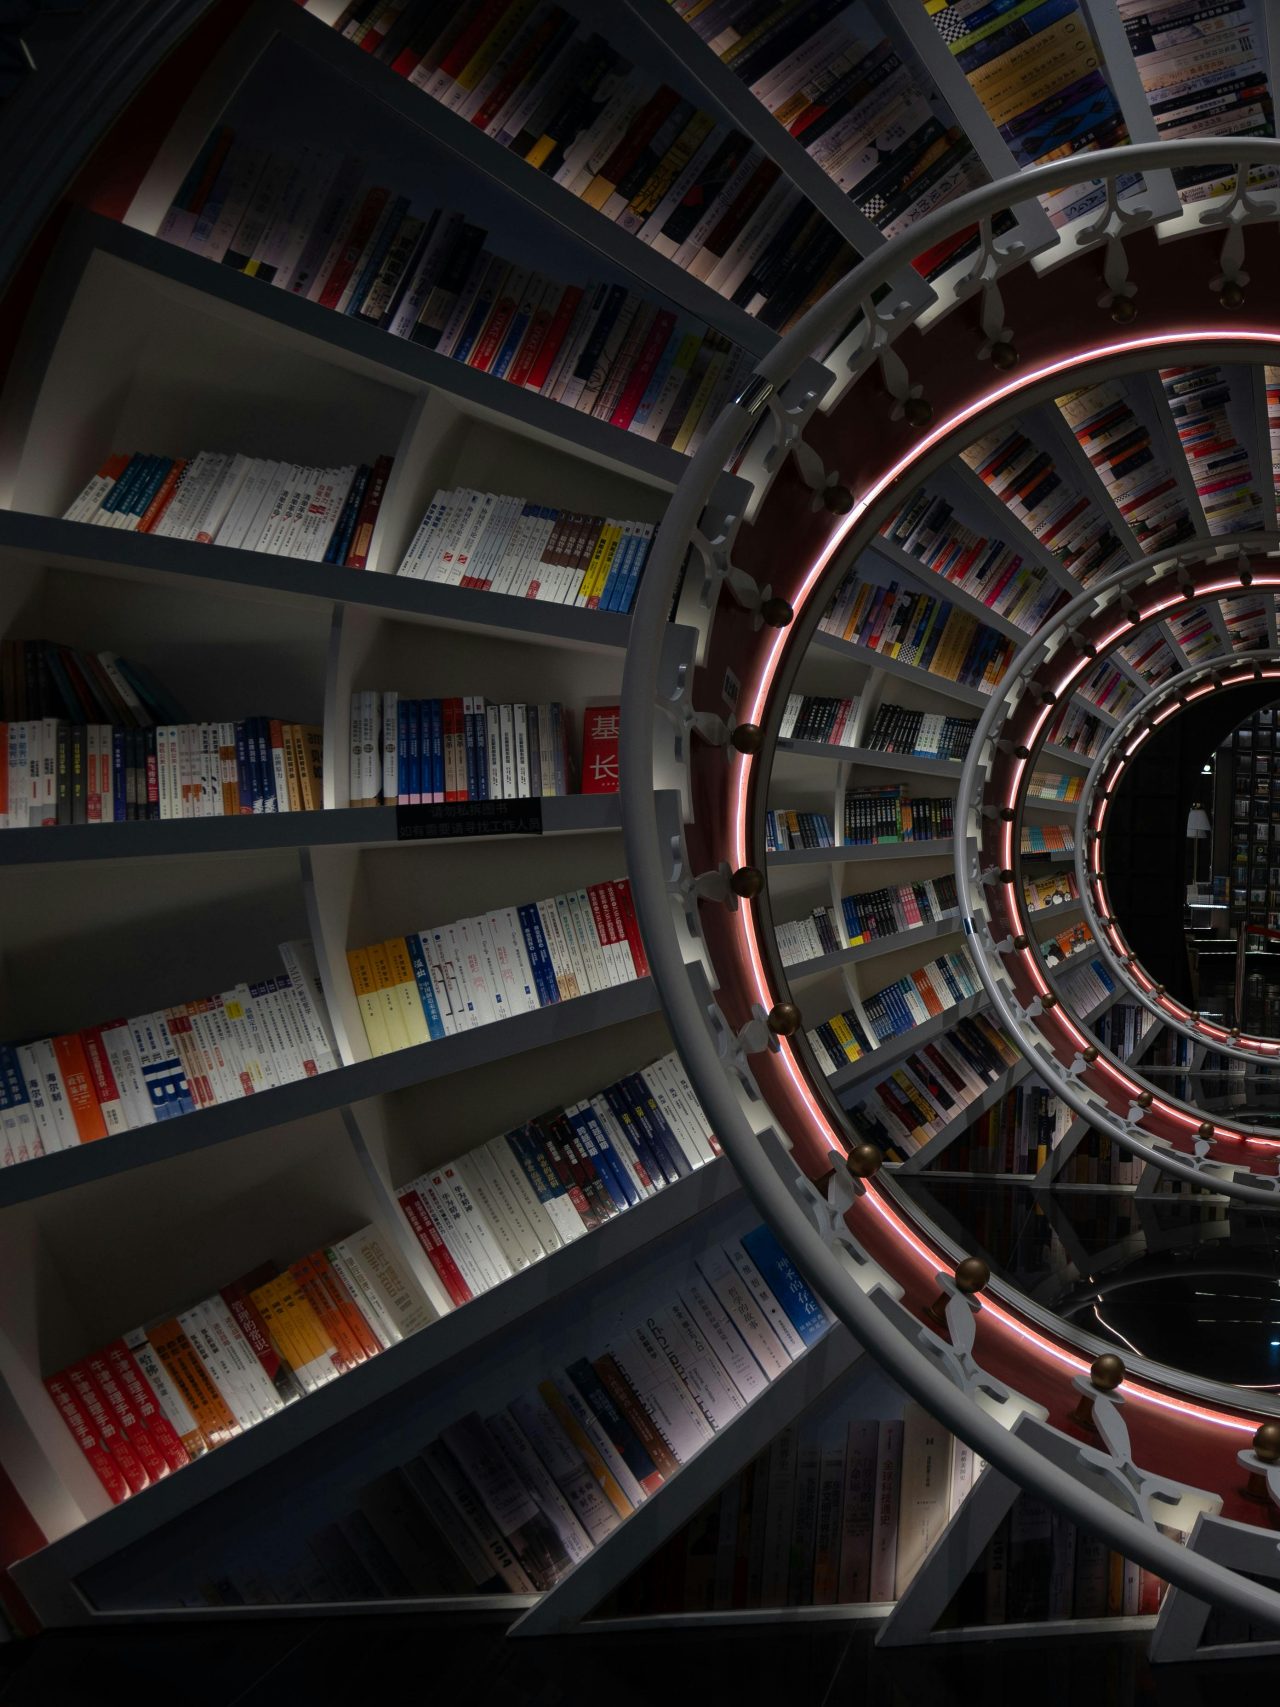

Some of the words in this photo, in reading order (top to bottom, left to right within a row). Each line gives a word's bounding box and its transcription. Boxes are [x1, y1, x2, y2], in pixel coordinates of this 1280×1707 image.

[592, 714, 621, 740] 基
[589, 754, 619, 780] 长
[28, 1078, 45, 1109] 海尔制
[46, 1072, 62, 1102] 海尔制
[727, 1286, 760, 1331] 哲学的故事
[231, 1299, 269, 1351] 管理的常识
[880, 1459, 896, 1527] 全球科技通史
